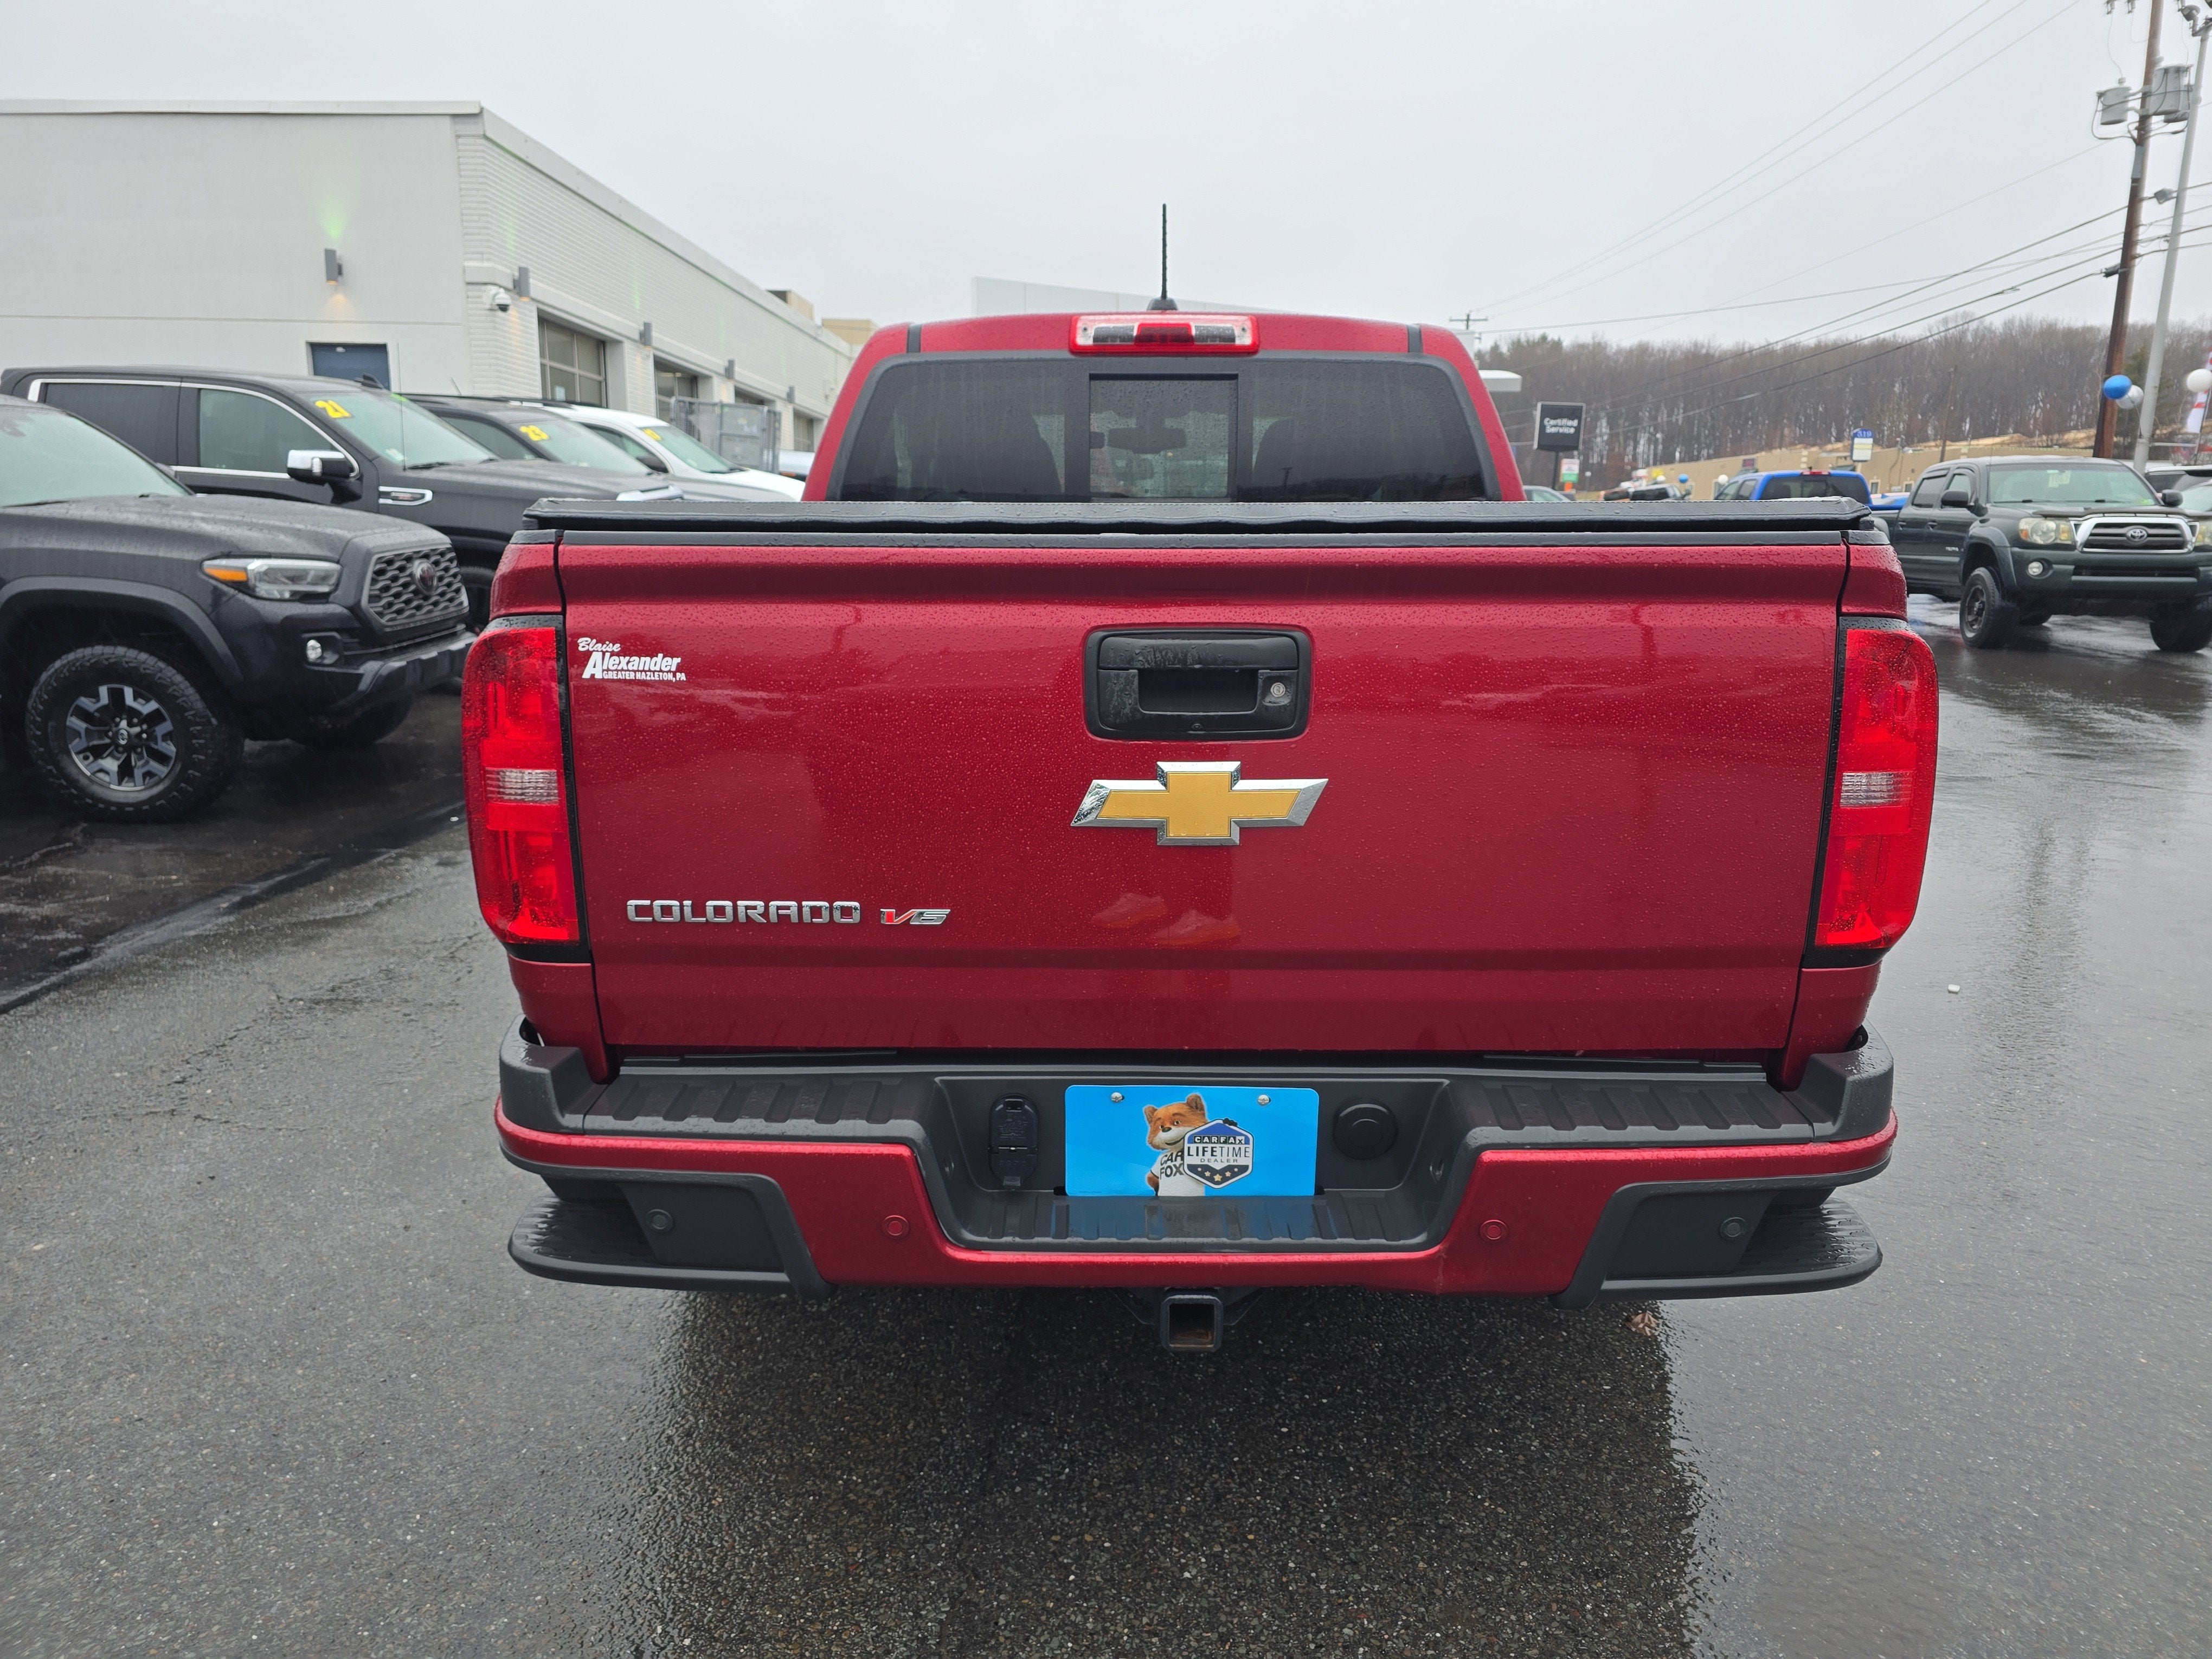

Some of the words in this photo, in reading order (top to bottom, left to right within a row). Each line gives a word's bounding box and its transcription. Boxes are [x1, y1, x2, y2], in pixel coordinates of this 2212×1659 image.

[1545, 426, 1575, 434] Service
[577, 637, 621, 652] Blaise
[582, 652, 681, 679] Alexander
[603, 671, 635, 679] GREATER
[636, 671, 676, 682] HAZLETON,
[676, 672, 686, 681] PA
[627, 899, 860, 923] COLORADO
[880, 908, 951, 925] V6
[1194, 1136, 1245, 1144] CARFAX
[1160, 1150, 1184, 1166] CAR
[1187, 1146, 1250, 1158] LIFETIME
[1160, 1162, 1185, 1180] FOX
